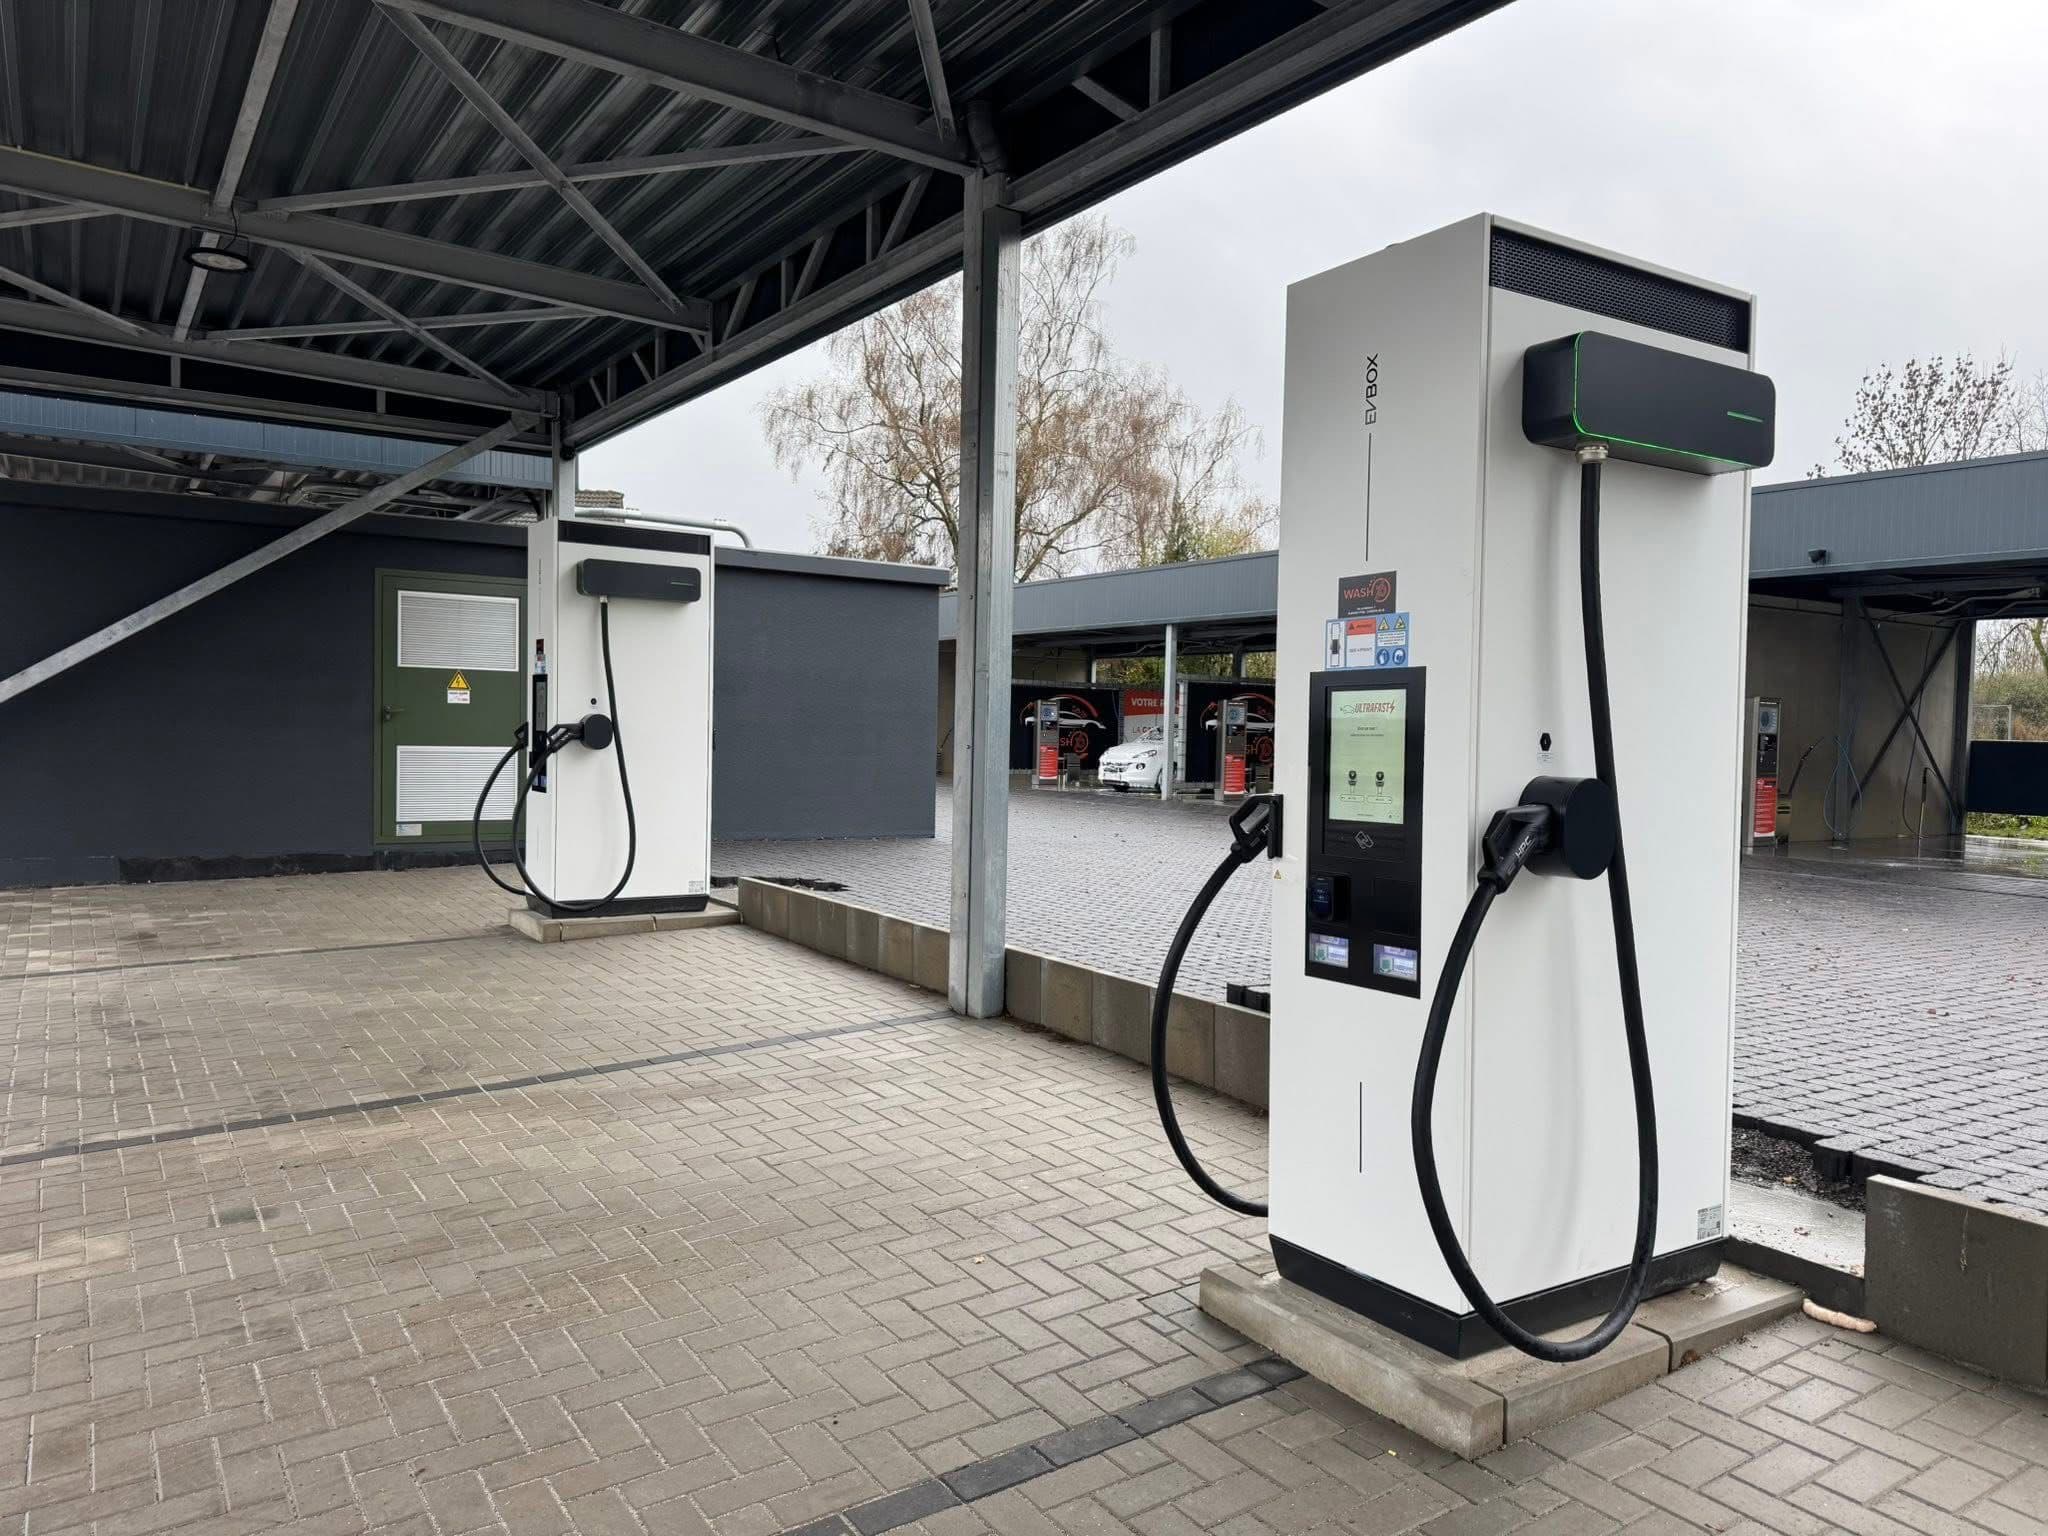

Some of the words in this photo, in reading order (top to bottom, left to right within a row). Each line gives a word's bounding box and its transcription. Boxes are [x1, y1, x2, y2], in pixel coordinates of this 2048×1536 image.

[1365, 353, 1378, 425] EVBOX
[1343, 586, 1374, 600] WASH
[1131, 697, 1159, 707] VOTRE
[1354, 702, 1391, 713] ULTRAFAST
